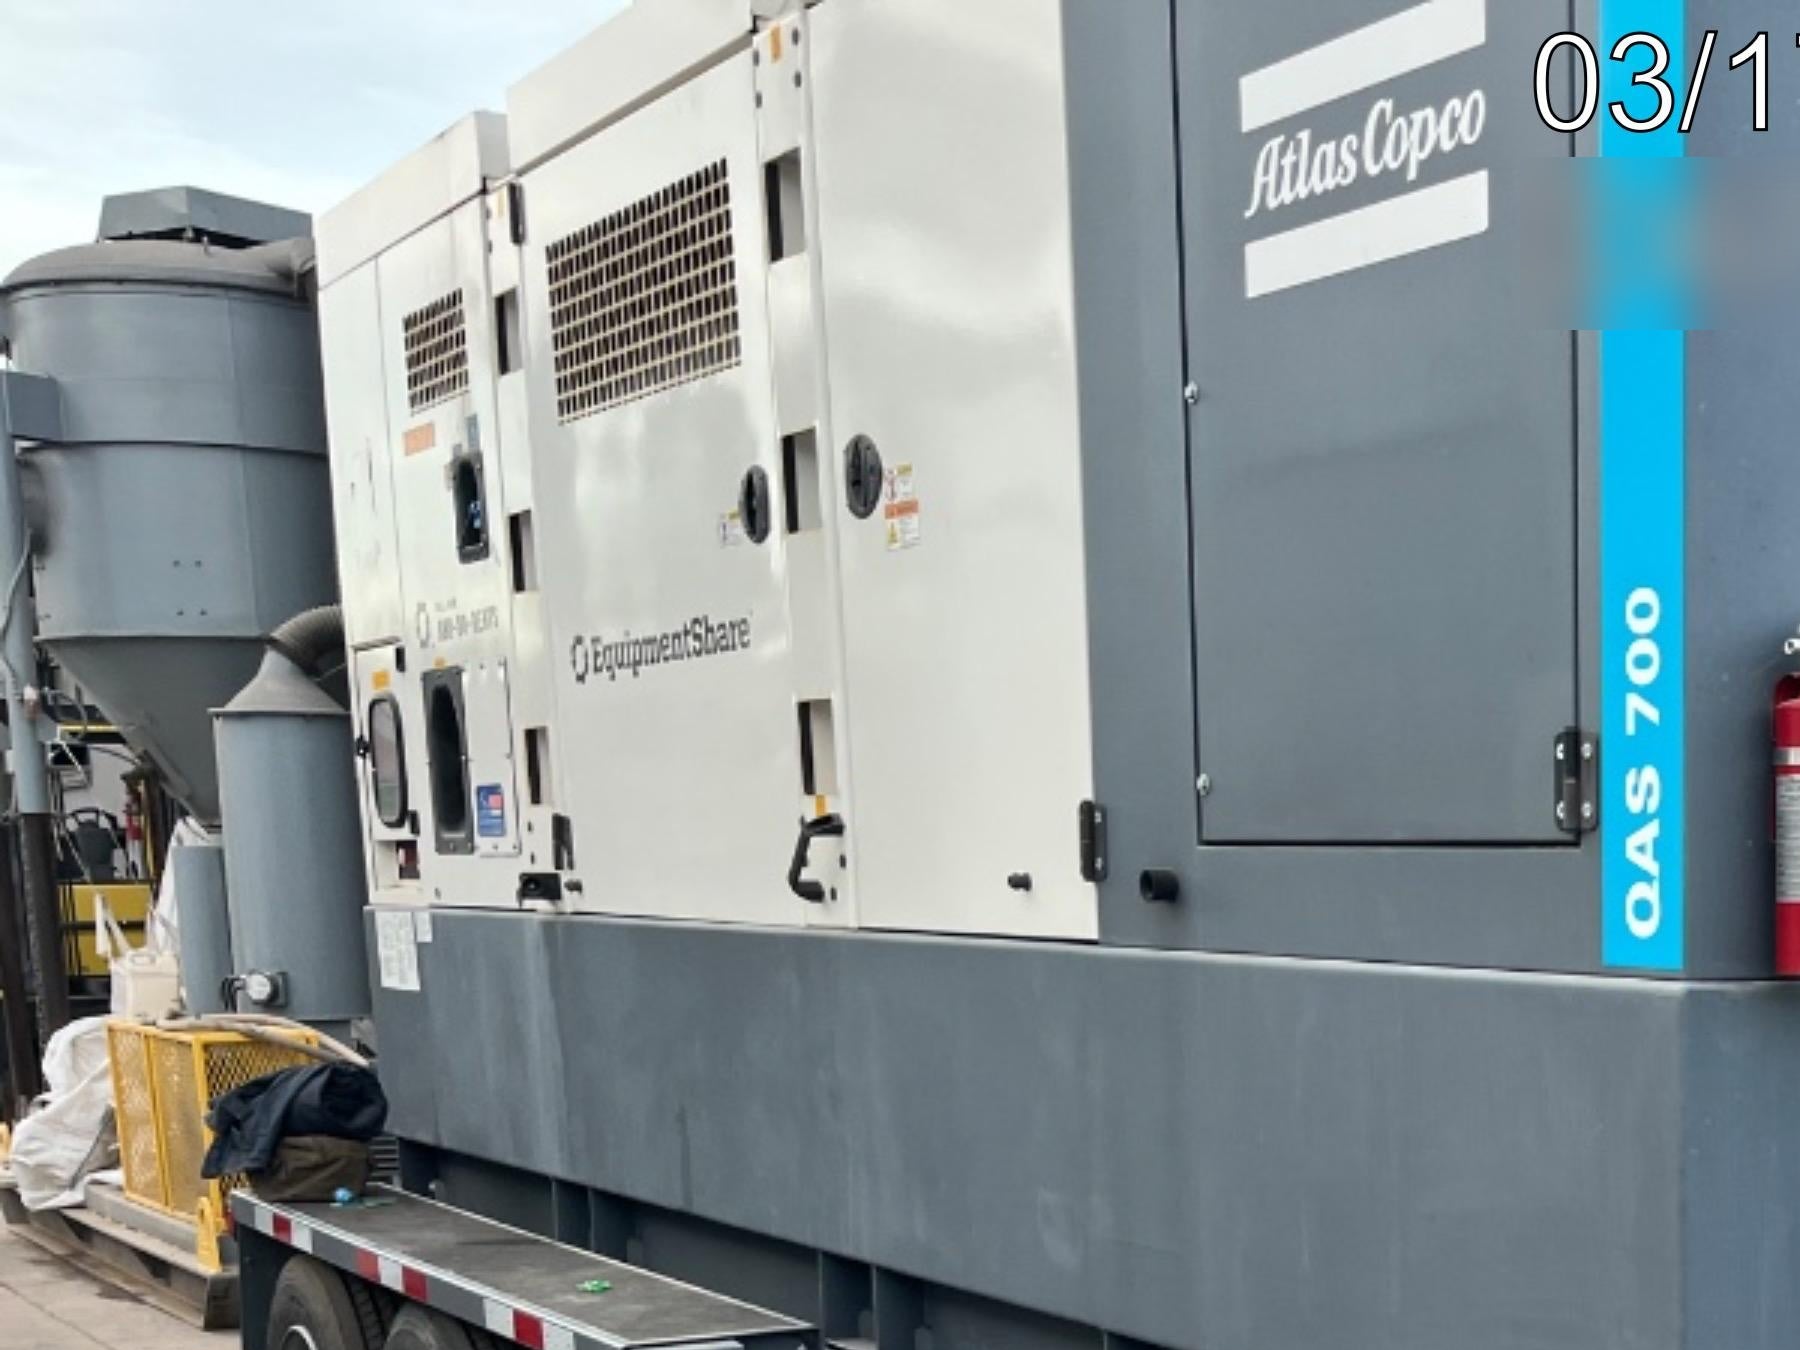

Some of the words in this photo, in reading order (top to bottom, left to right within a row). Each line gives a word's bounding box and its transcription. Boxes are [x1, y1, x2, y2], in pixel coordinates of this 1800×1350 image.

[590, 614, 752, 682] EquipmentShare
[1624, 586, 1662, 737] 700
[1624, 763, 1662, 940] QAS
